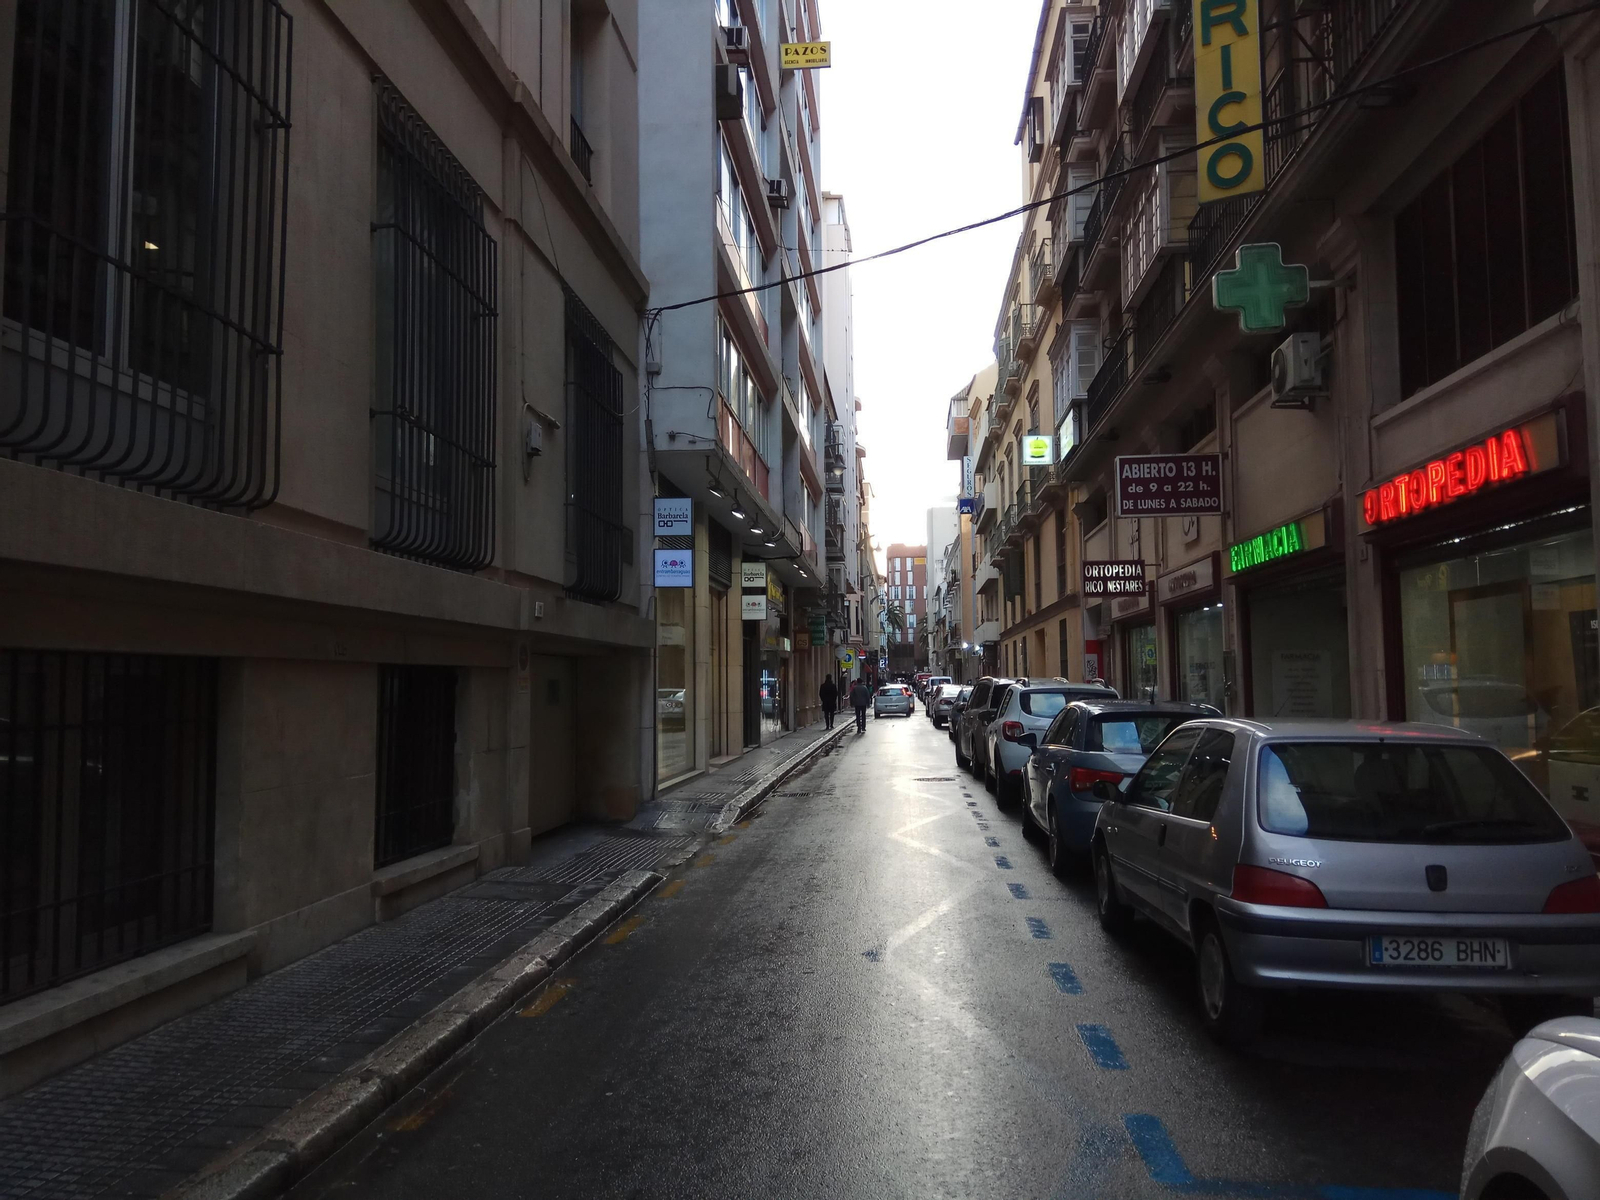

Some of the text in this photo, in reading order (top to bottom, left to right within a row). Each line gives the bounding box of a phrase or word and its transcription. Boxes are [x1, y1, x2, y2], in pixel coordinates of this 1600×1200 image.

[784, 46, 827, 56] PAZOS
[1201, 0, 1253, 190] RICO
[1122, 460, 1216, 479] ABIERTO 13 H.
[1363, 429, 1524, 525] ORTOPEDIA
[1127, 480, 1211, 493] de 9 a 22 h.
[1123, 497, 1219, 510] DE LUNES A SABADO
[1230, 522, 1300, 572] FARMACIA
[1084, 564, 1143, 578] ORTOPEDIA
[1084, 579, 1143, 593] RICO NESTARES
[1268, 857, 1322, 868] PEUGEOT
[1388, 940, 1497, 962] 3286 BHN
